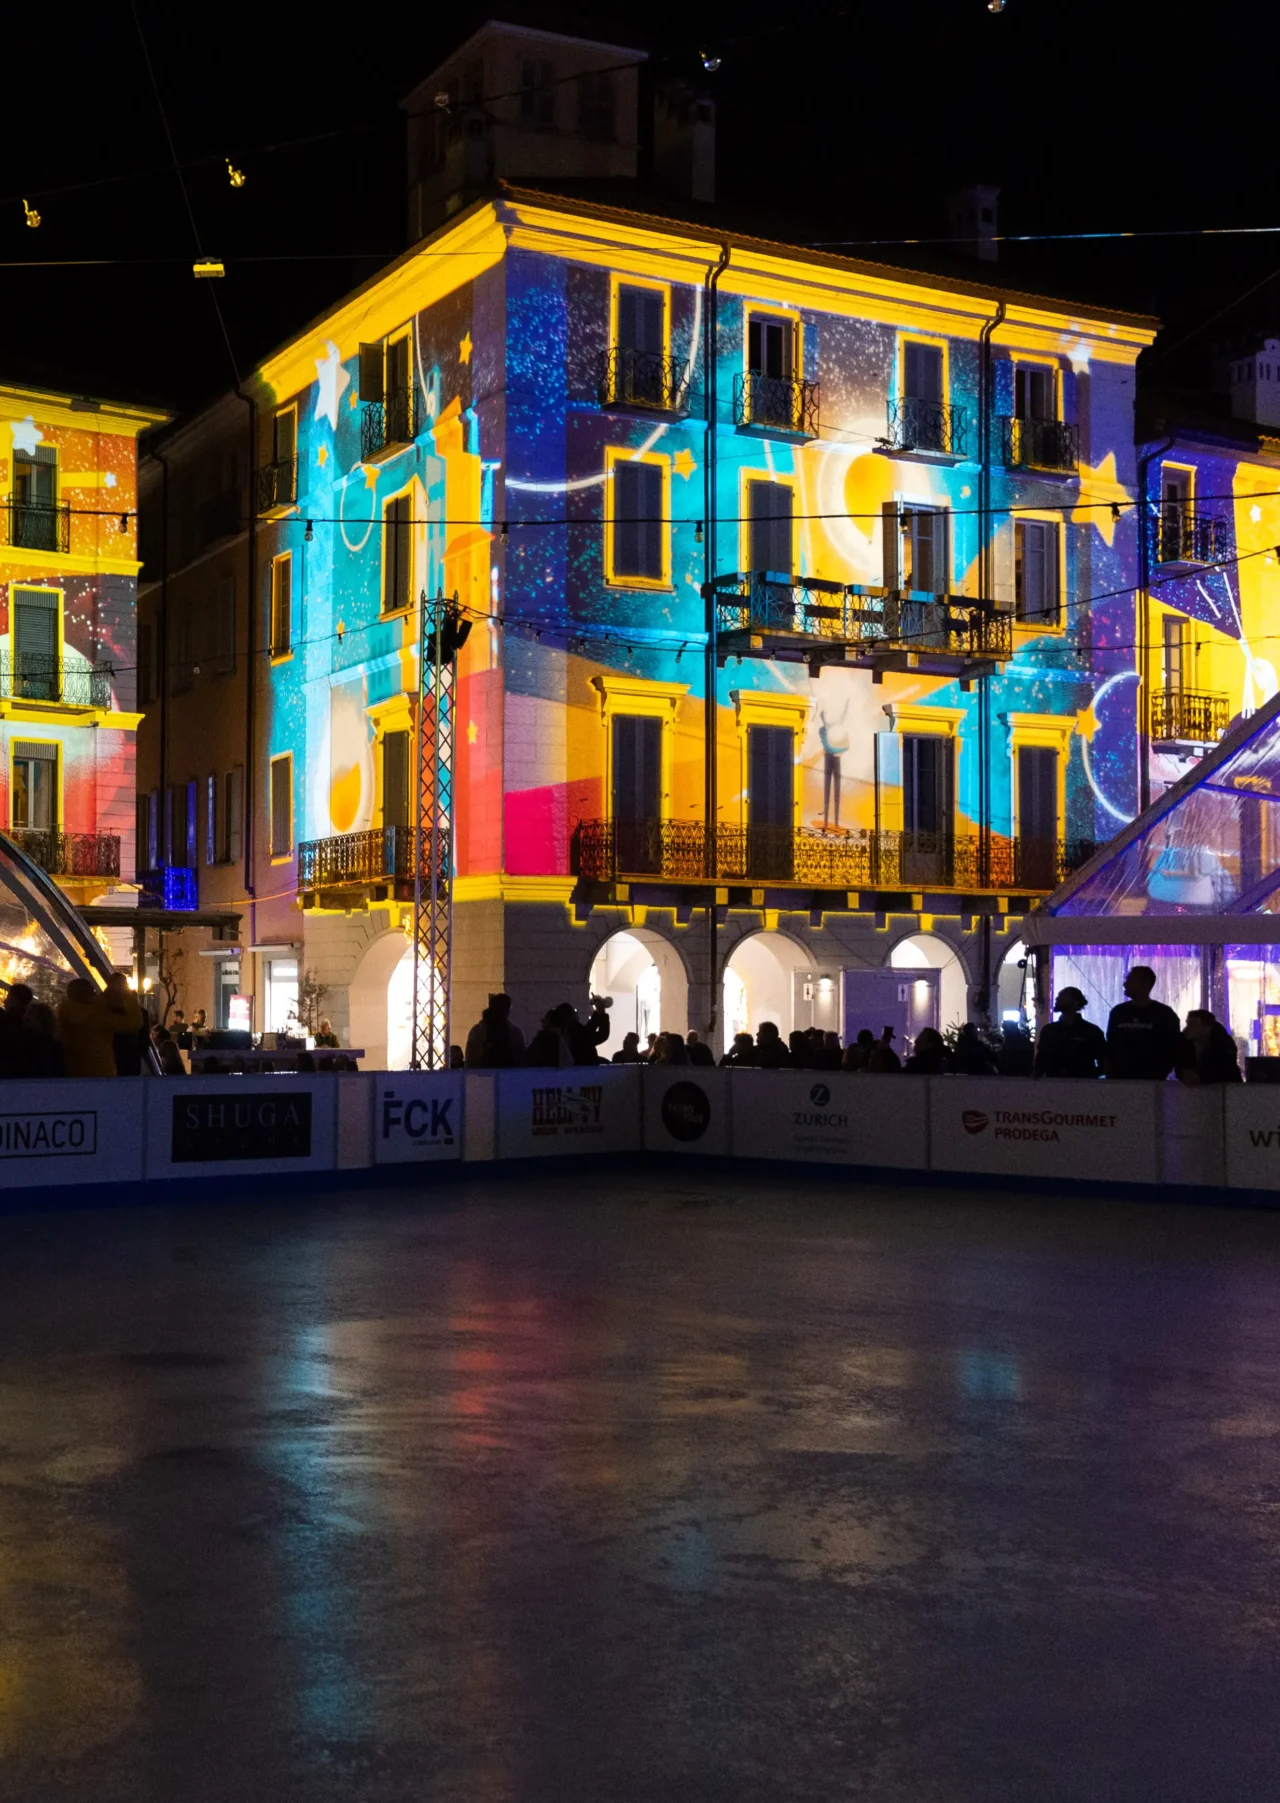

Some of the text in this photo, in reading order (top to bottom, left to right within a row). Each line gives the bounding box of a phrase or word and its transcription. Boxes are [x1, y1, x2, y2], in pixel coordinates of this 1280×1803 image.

[185, 1101, 300, 1130] SHUGA
[382, 1098, 454, 1139] FCK
[793, 1112, 848, 1128] ZURICH
[993, 1110, 1117, 1128] TRANSGOURMET
[994, 1127, 1061, 1143] PRODEGA
